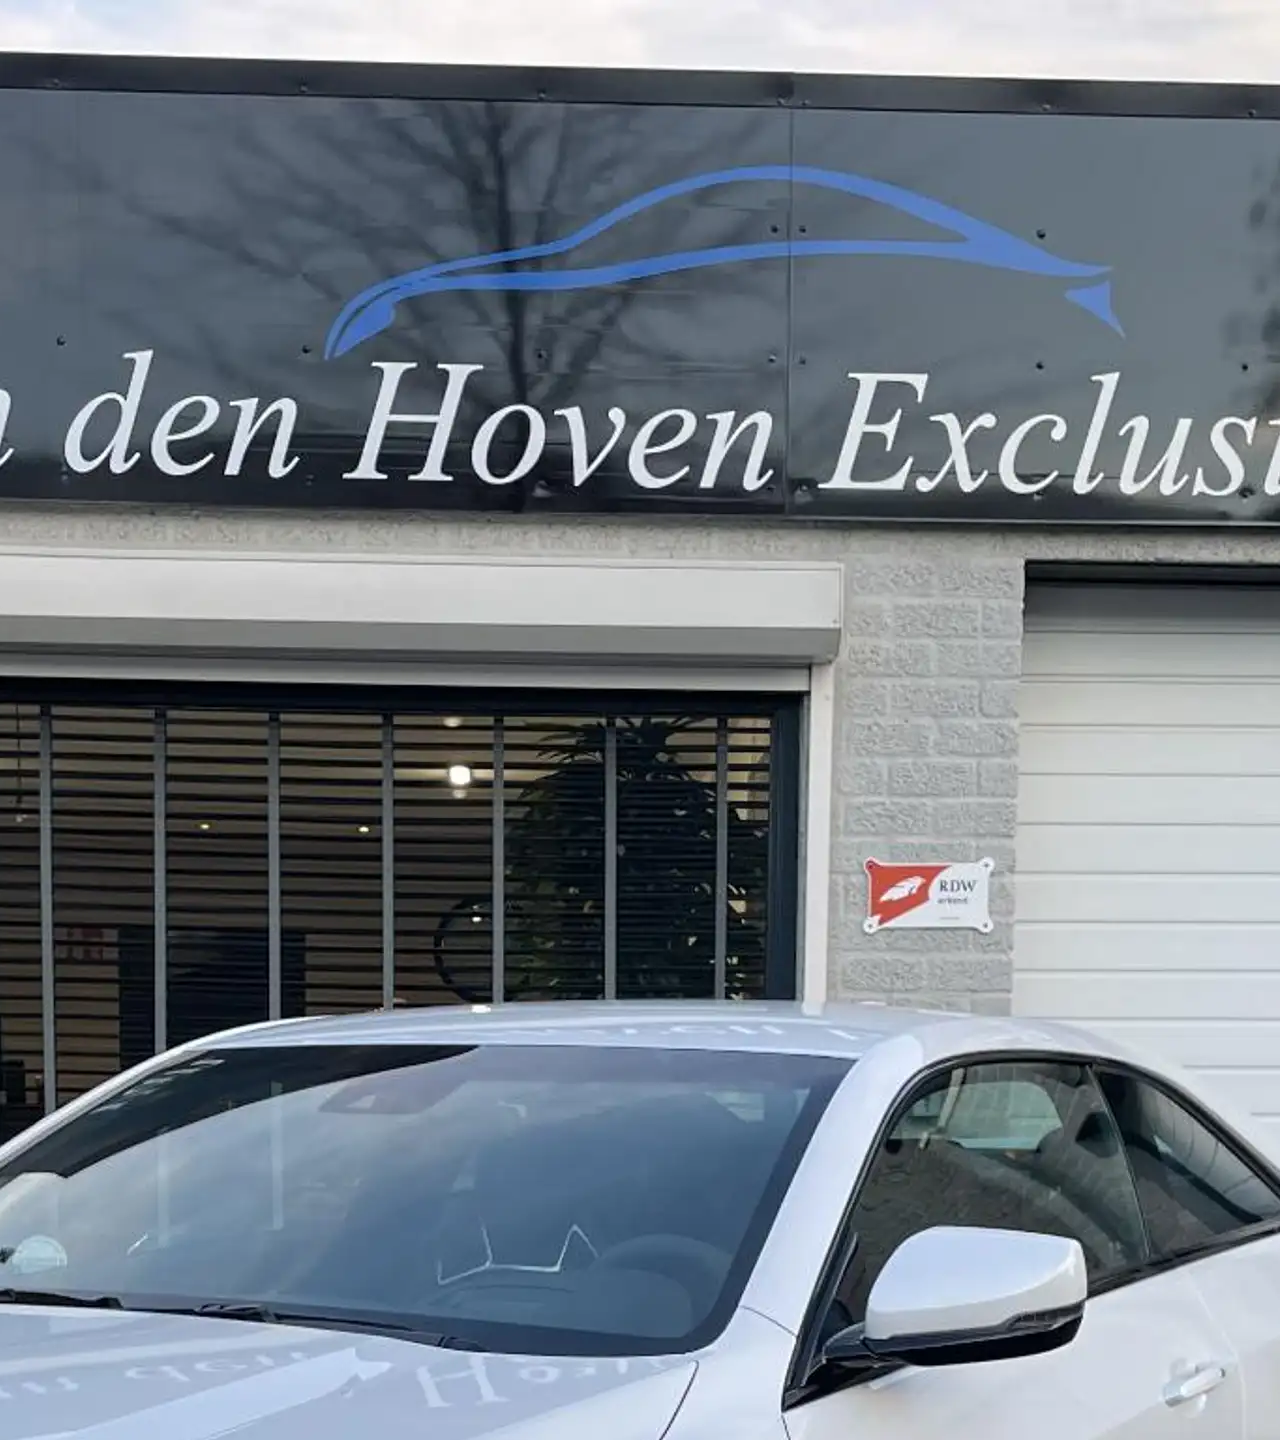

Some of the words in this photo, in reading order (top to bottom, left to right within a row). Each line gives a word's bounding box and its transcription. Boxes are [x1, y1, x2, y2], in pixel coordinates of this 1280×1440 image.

[63, 348, 300, 479] den
[342, 361, 774, 491] Hoven
[940, 879, 977, 892] RDW
